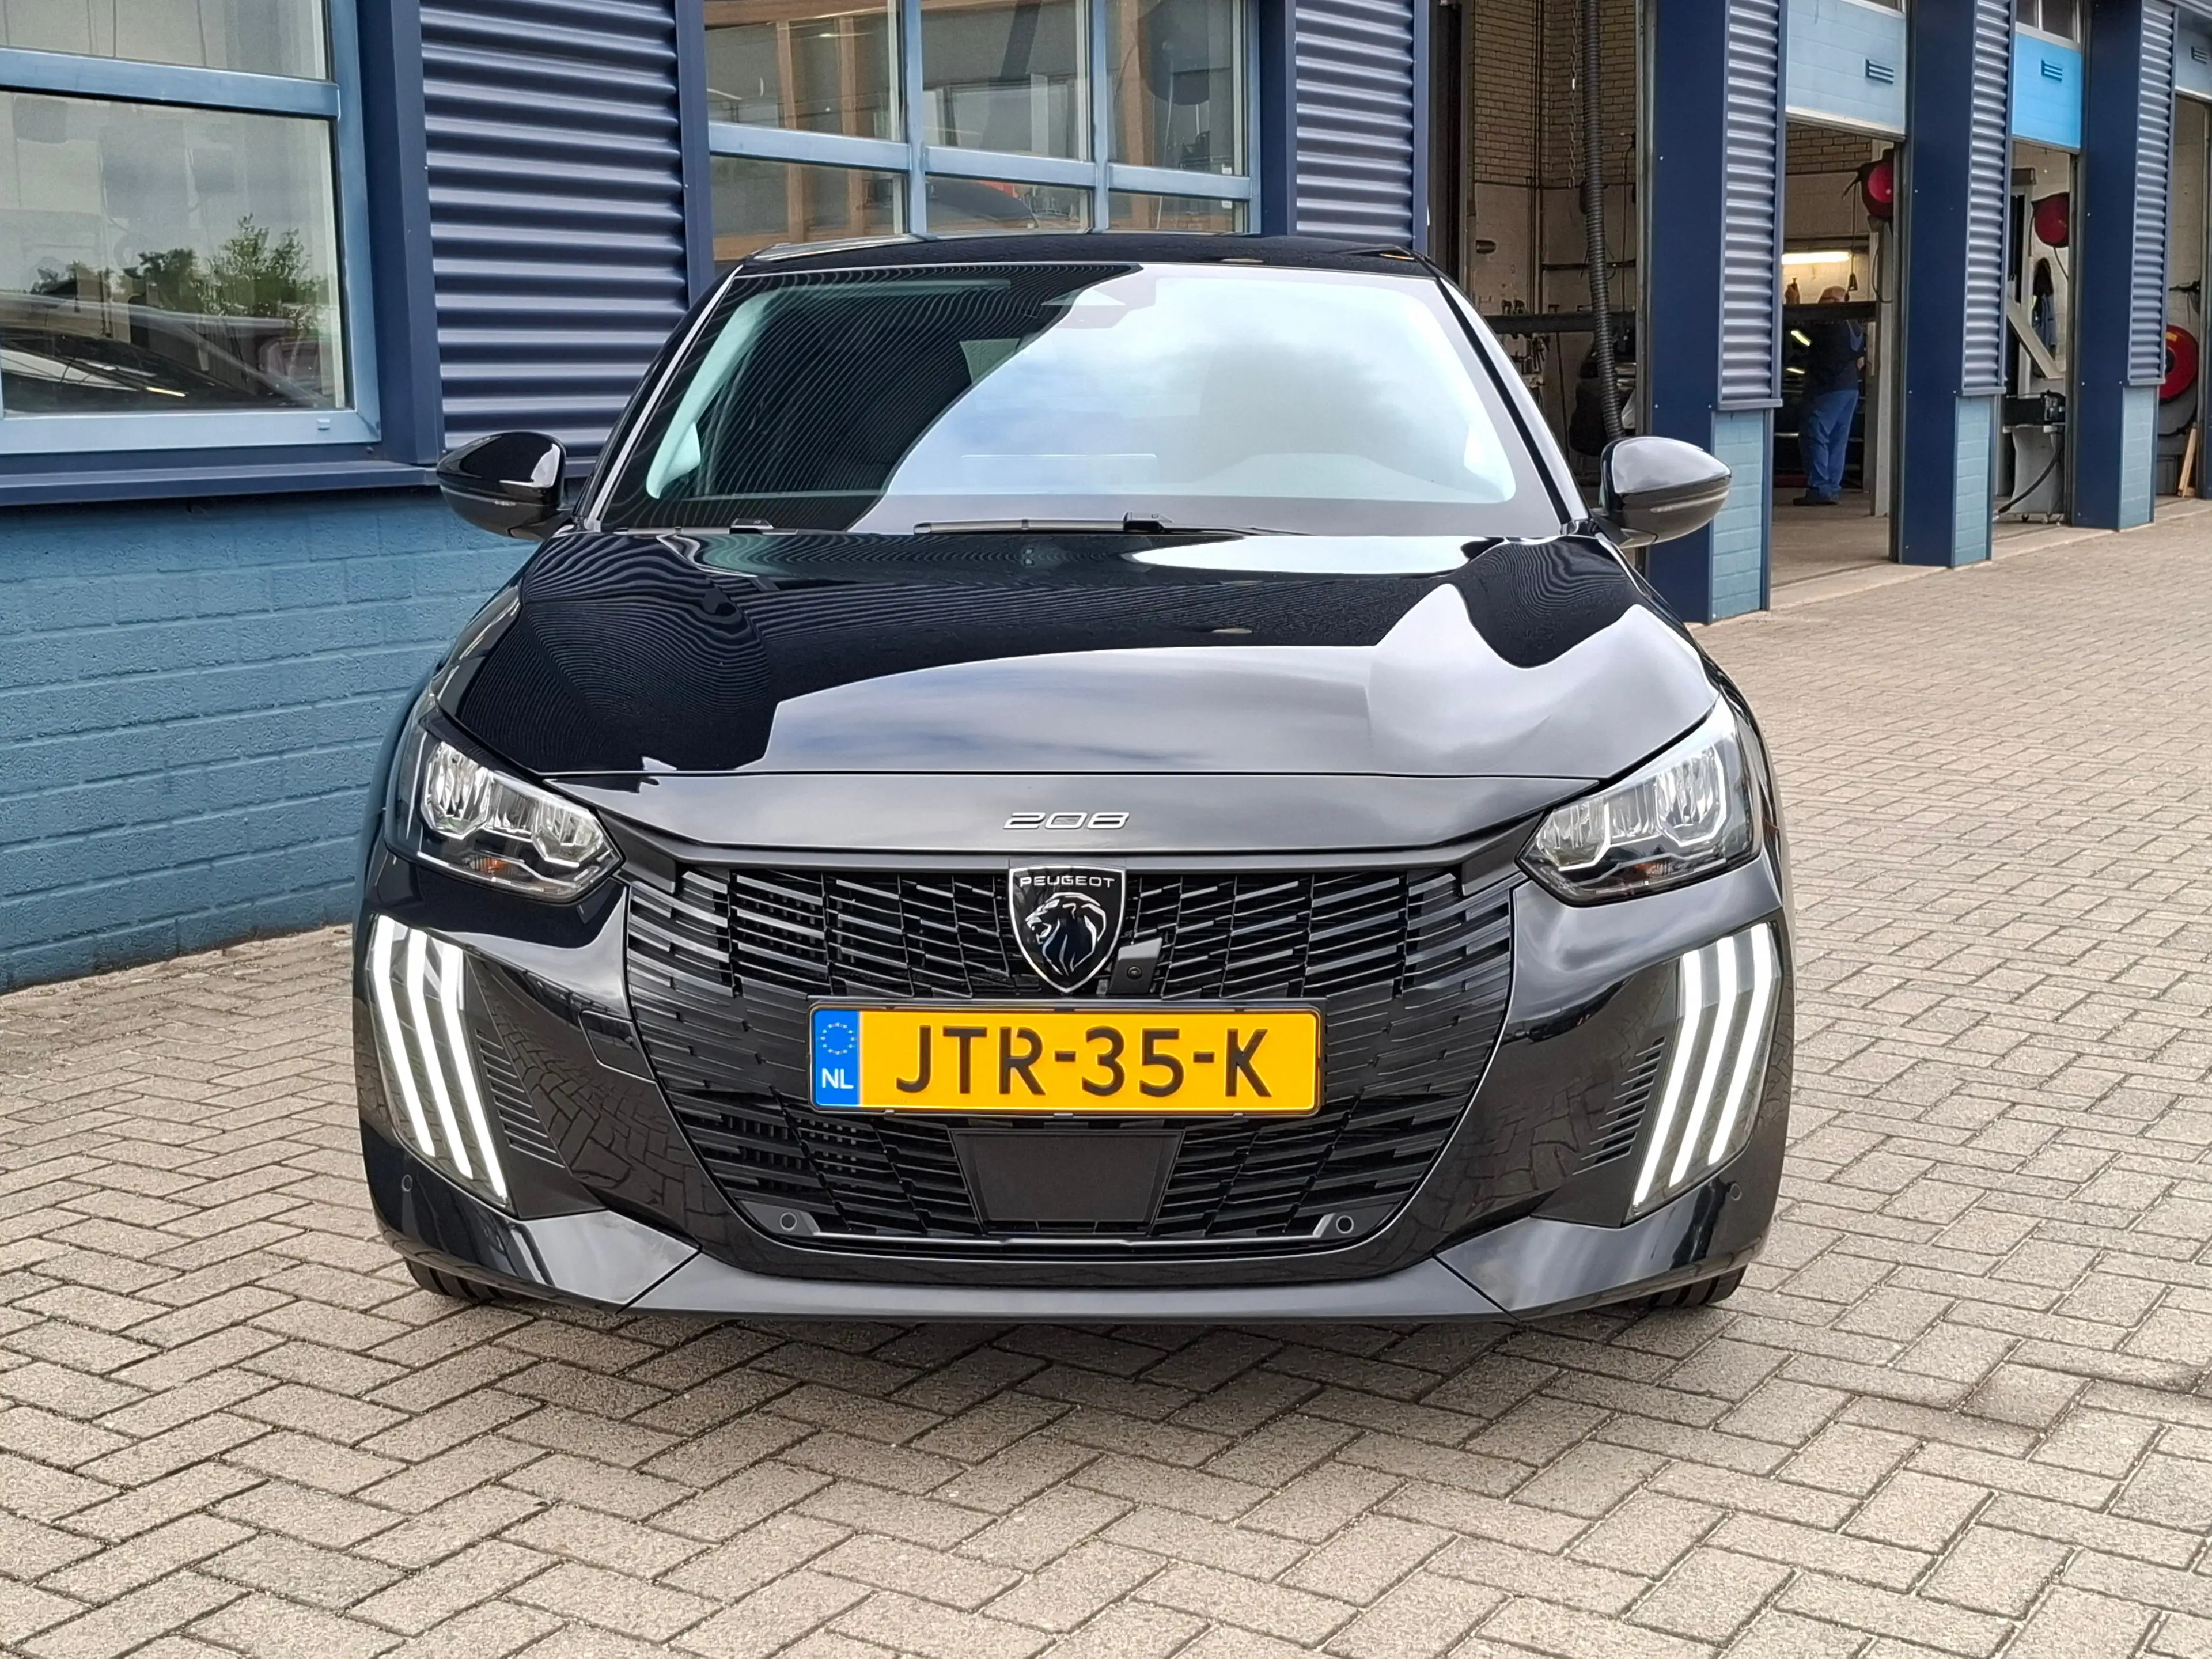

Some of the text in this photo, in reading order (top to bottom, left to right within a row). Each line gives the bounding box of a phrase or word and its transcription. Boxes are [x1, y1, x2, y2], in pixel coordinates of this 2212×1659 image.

[1003, 812, 1130, 830] 208
[1019, 874, 1115, 888] PEUGEOT
[896, 1024, 1272, 1098] JTR-35-K
[821, 1067, 854, 1089] NL
